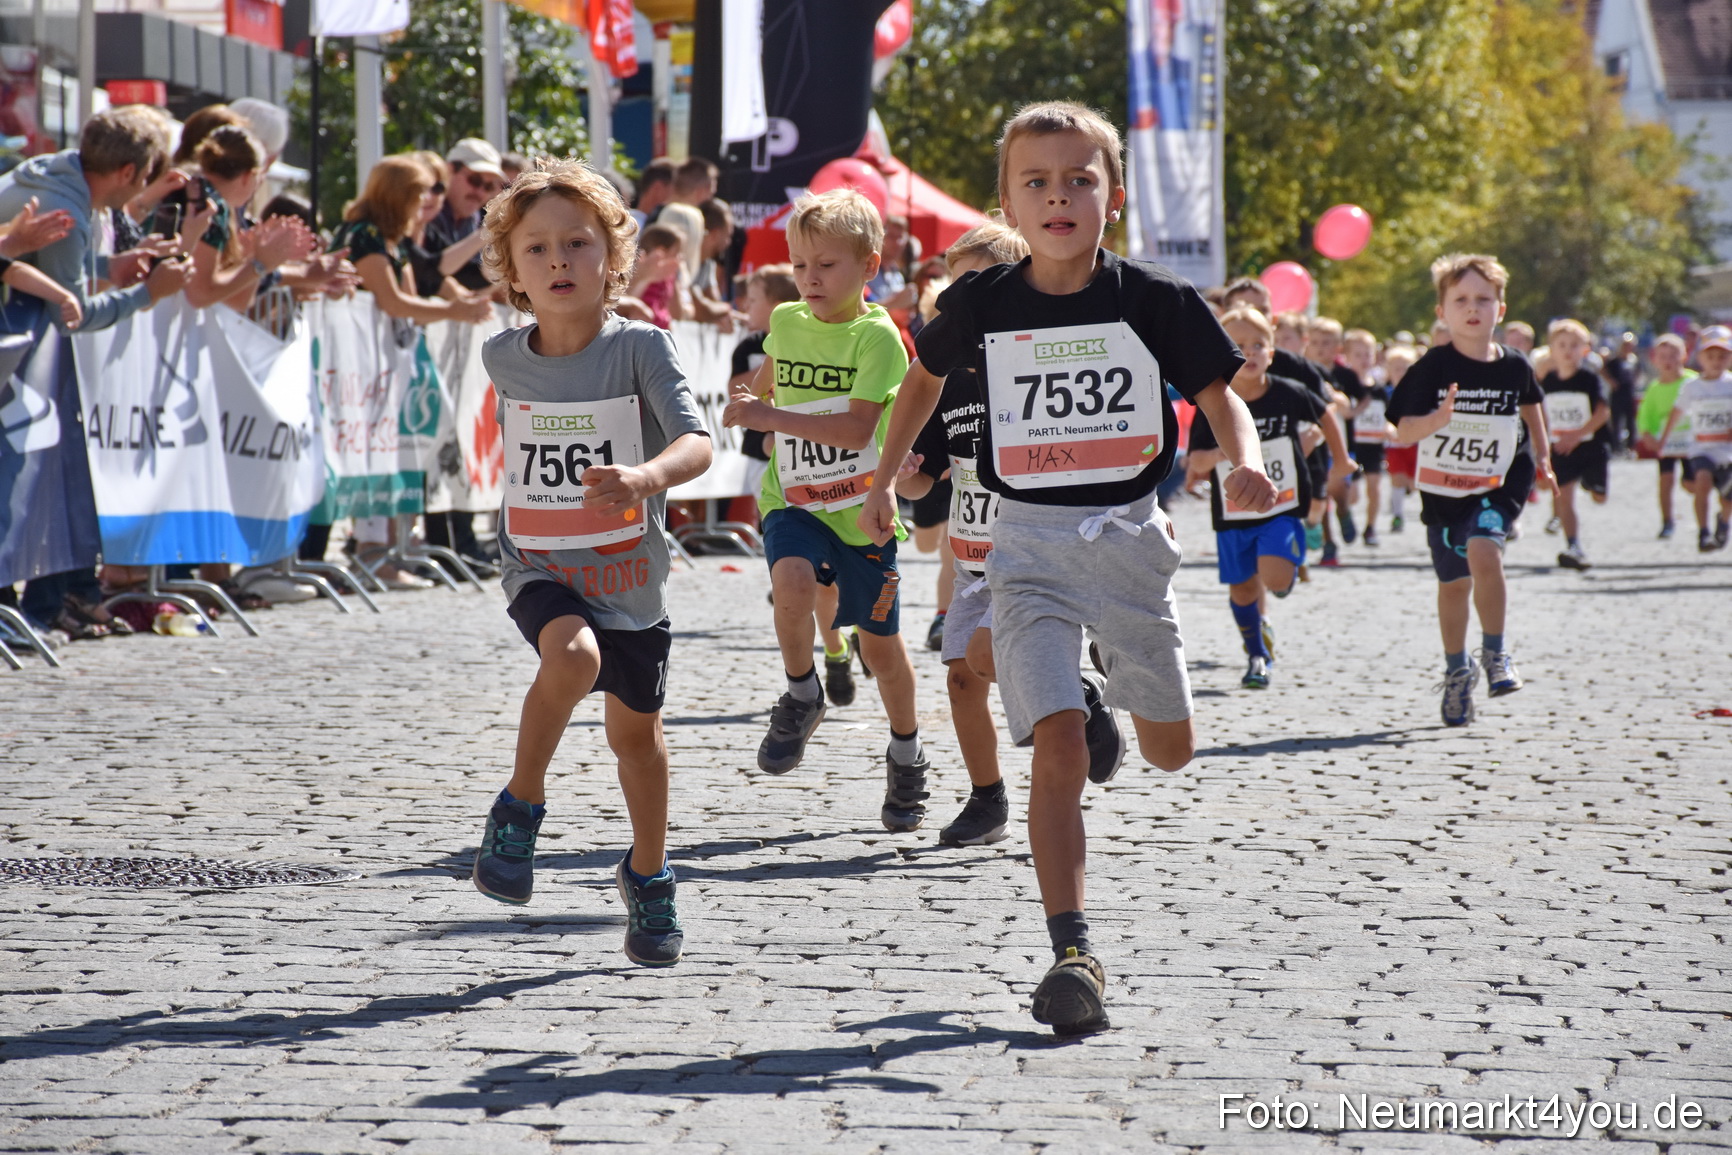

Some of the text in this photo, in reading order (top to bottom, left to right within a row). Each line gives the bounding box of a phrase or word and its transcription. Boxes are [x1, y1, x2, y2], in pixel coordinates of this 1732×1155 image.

[1034, 338, 1108, 359] BOCK
[1084, 354, 1110, 362] concepts
[777, 359, 857, 392] BOCK
[1014, 366, 1135, 420] 7532
[532, 414, 596, 430] BOCK
[1028, 423, 1113, 437] PARTL Neumarkt
[1434, 434, 1500, 464] 7454
[519, 439, 614, 488] 7561
[1027, 445, 1077, 472] MAX
[812, 468, 846, 480] Neumarkt
[1444, 475, 1481, 488] Fabian
[527, 494, 587, 503] PARTL Neum
